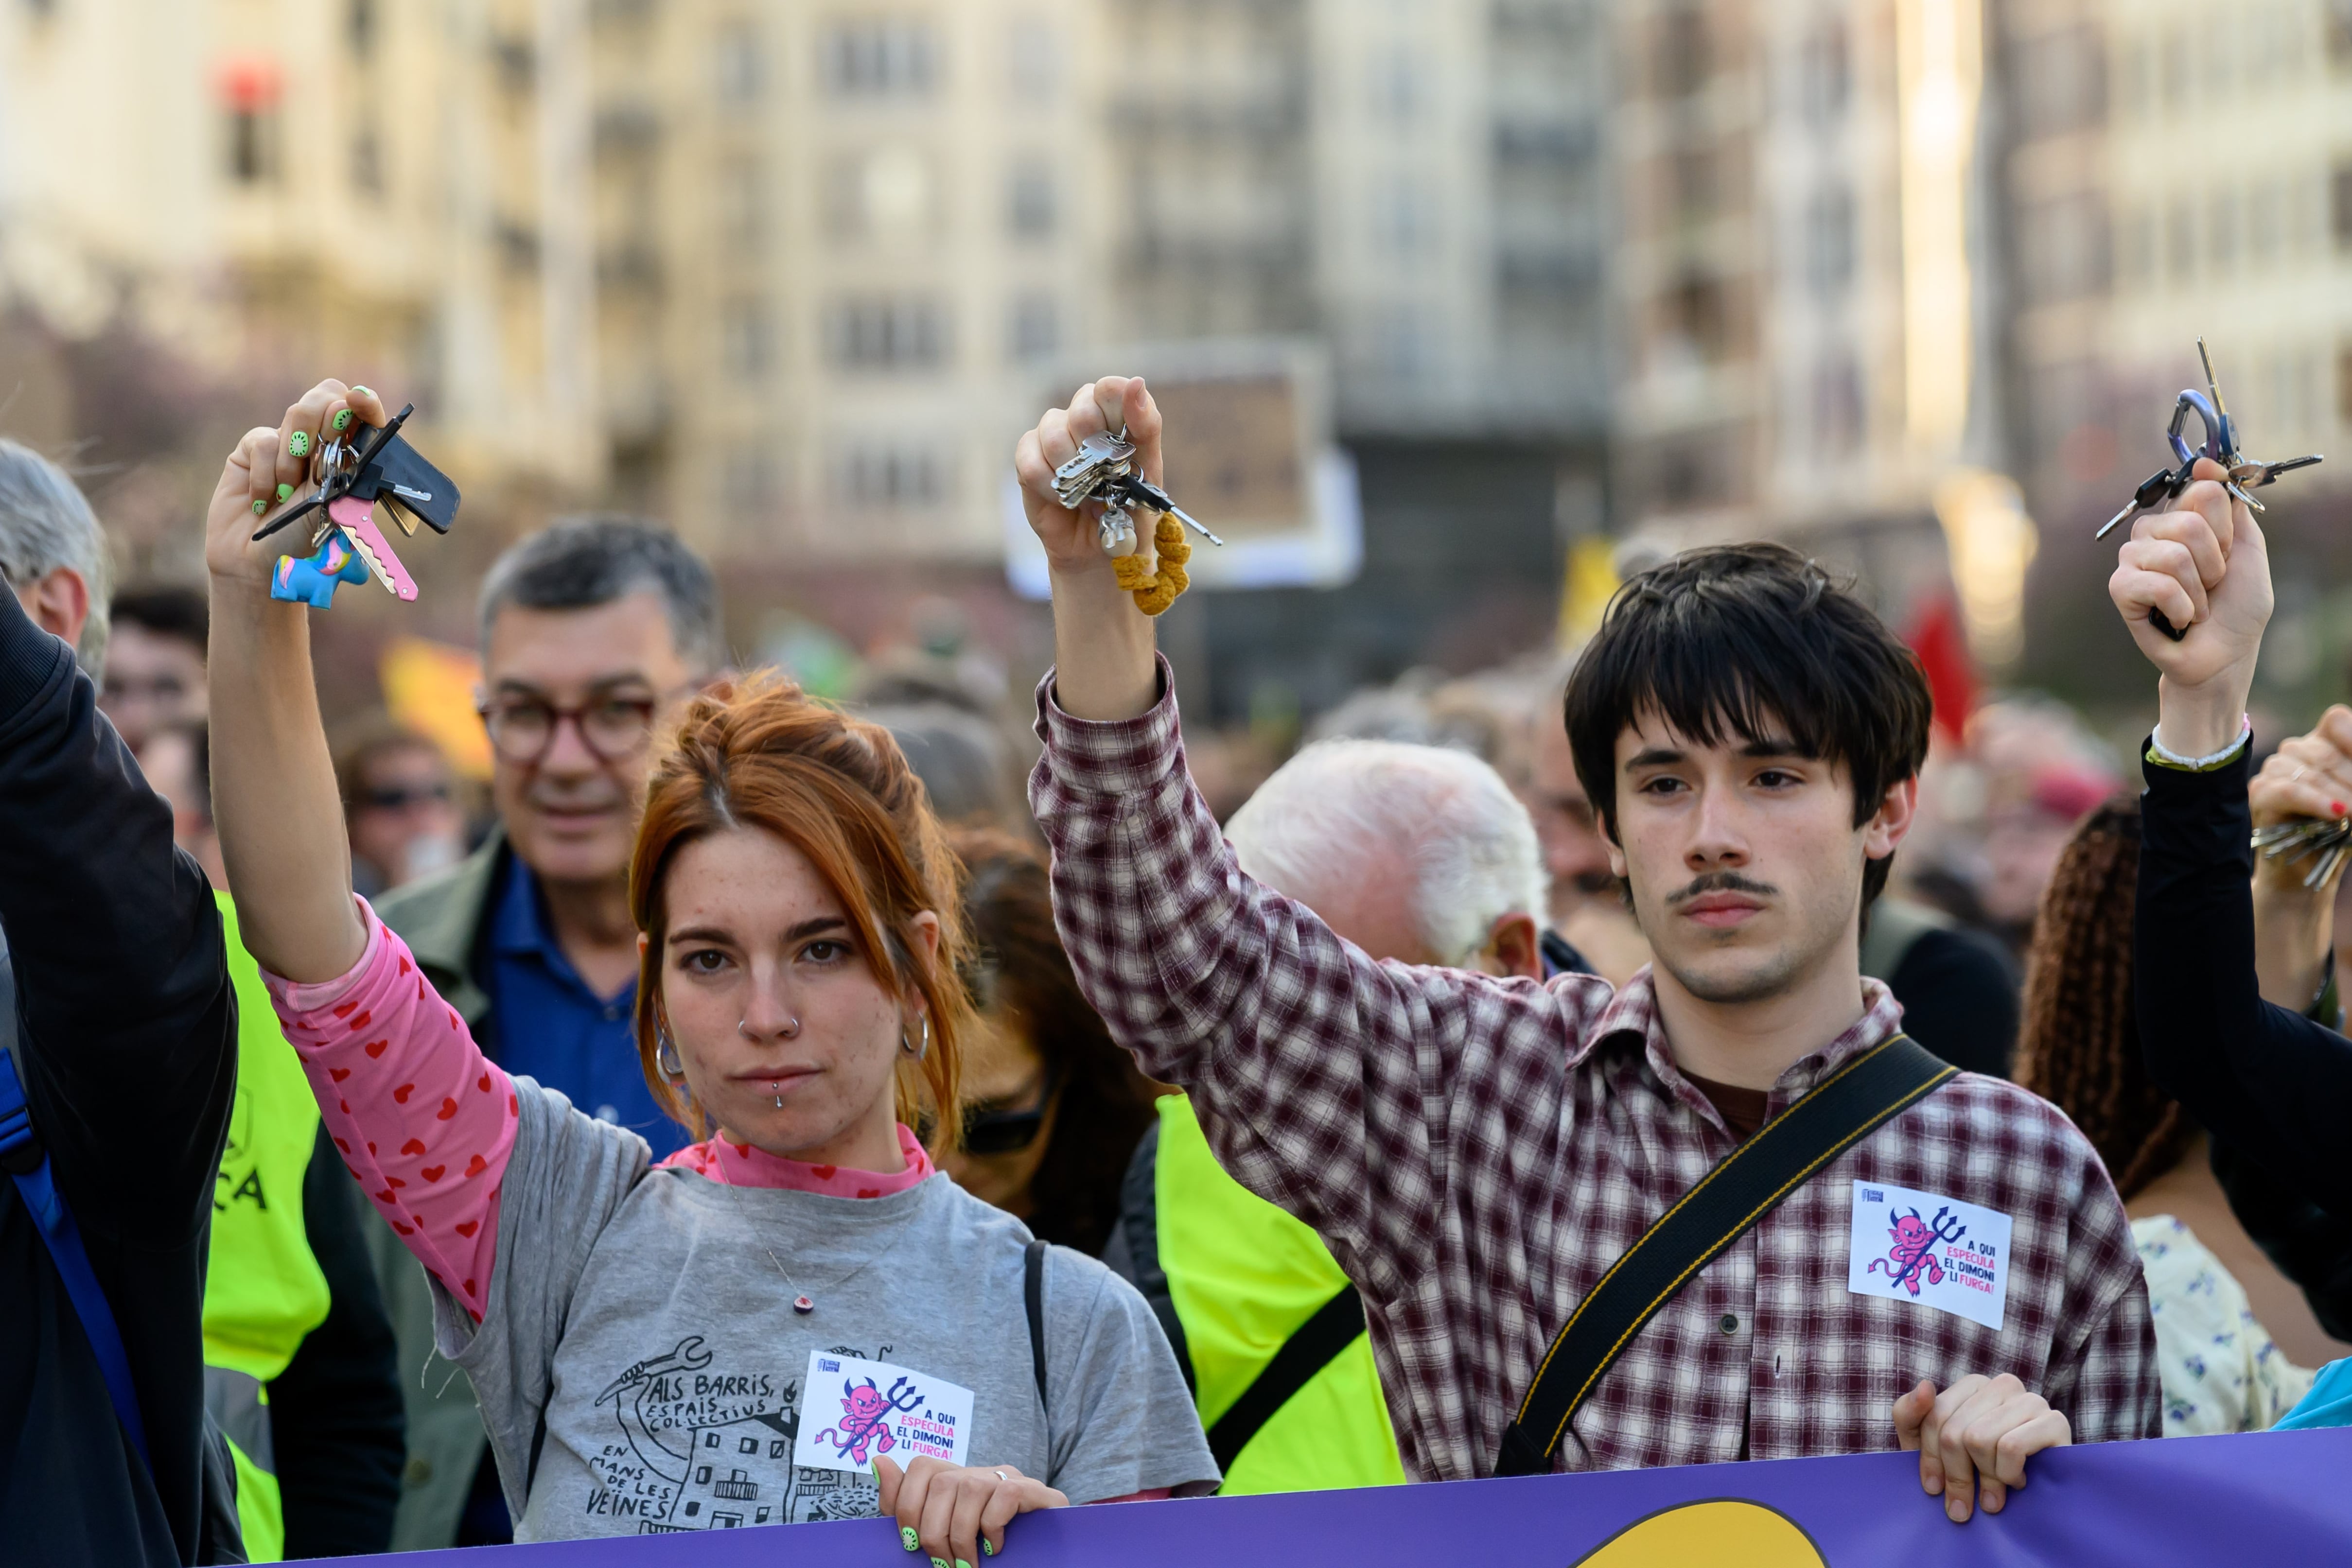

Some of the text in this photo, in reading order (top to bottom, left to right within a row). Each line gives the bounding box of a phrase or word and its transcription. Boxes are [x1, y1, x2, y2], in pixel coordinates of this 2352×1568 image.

[1947, 1246, 1995, 1270] ESPECULA
[1968, 1240, 1995, 1257] A QUI
[1945, 1257, 1994, 1282] EL DIMONI
[1950, 1271, 1994, 1295] LI FURGA!
[648, 1376, 683, 1403] ALS
[901, 1415, 954, 1438] ESPECULA
[925, 1409, 955, 1426] A QUI
[897, 1426, 953, 1449] EL DIMONI
[603, 1446, 628, 1456] EN
[901, 1439, 952, 1460] LI FURGA!
[589, 1457, 645, 1480] MANS
[607, 1475, 671, 1499] DE LES
[586, 1488, 669, 1519] VEÏNES
